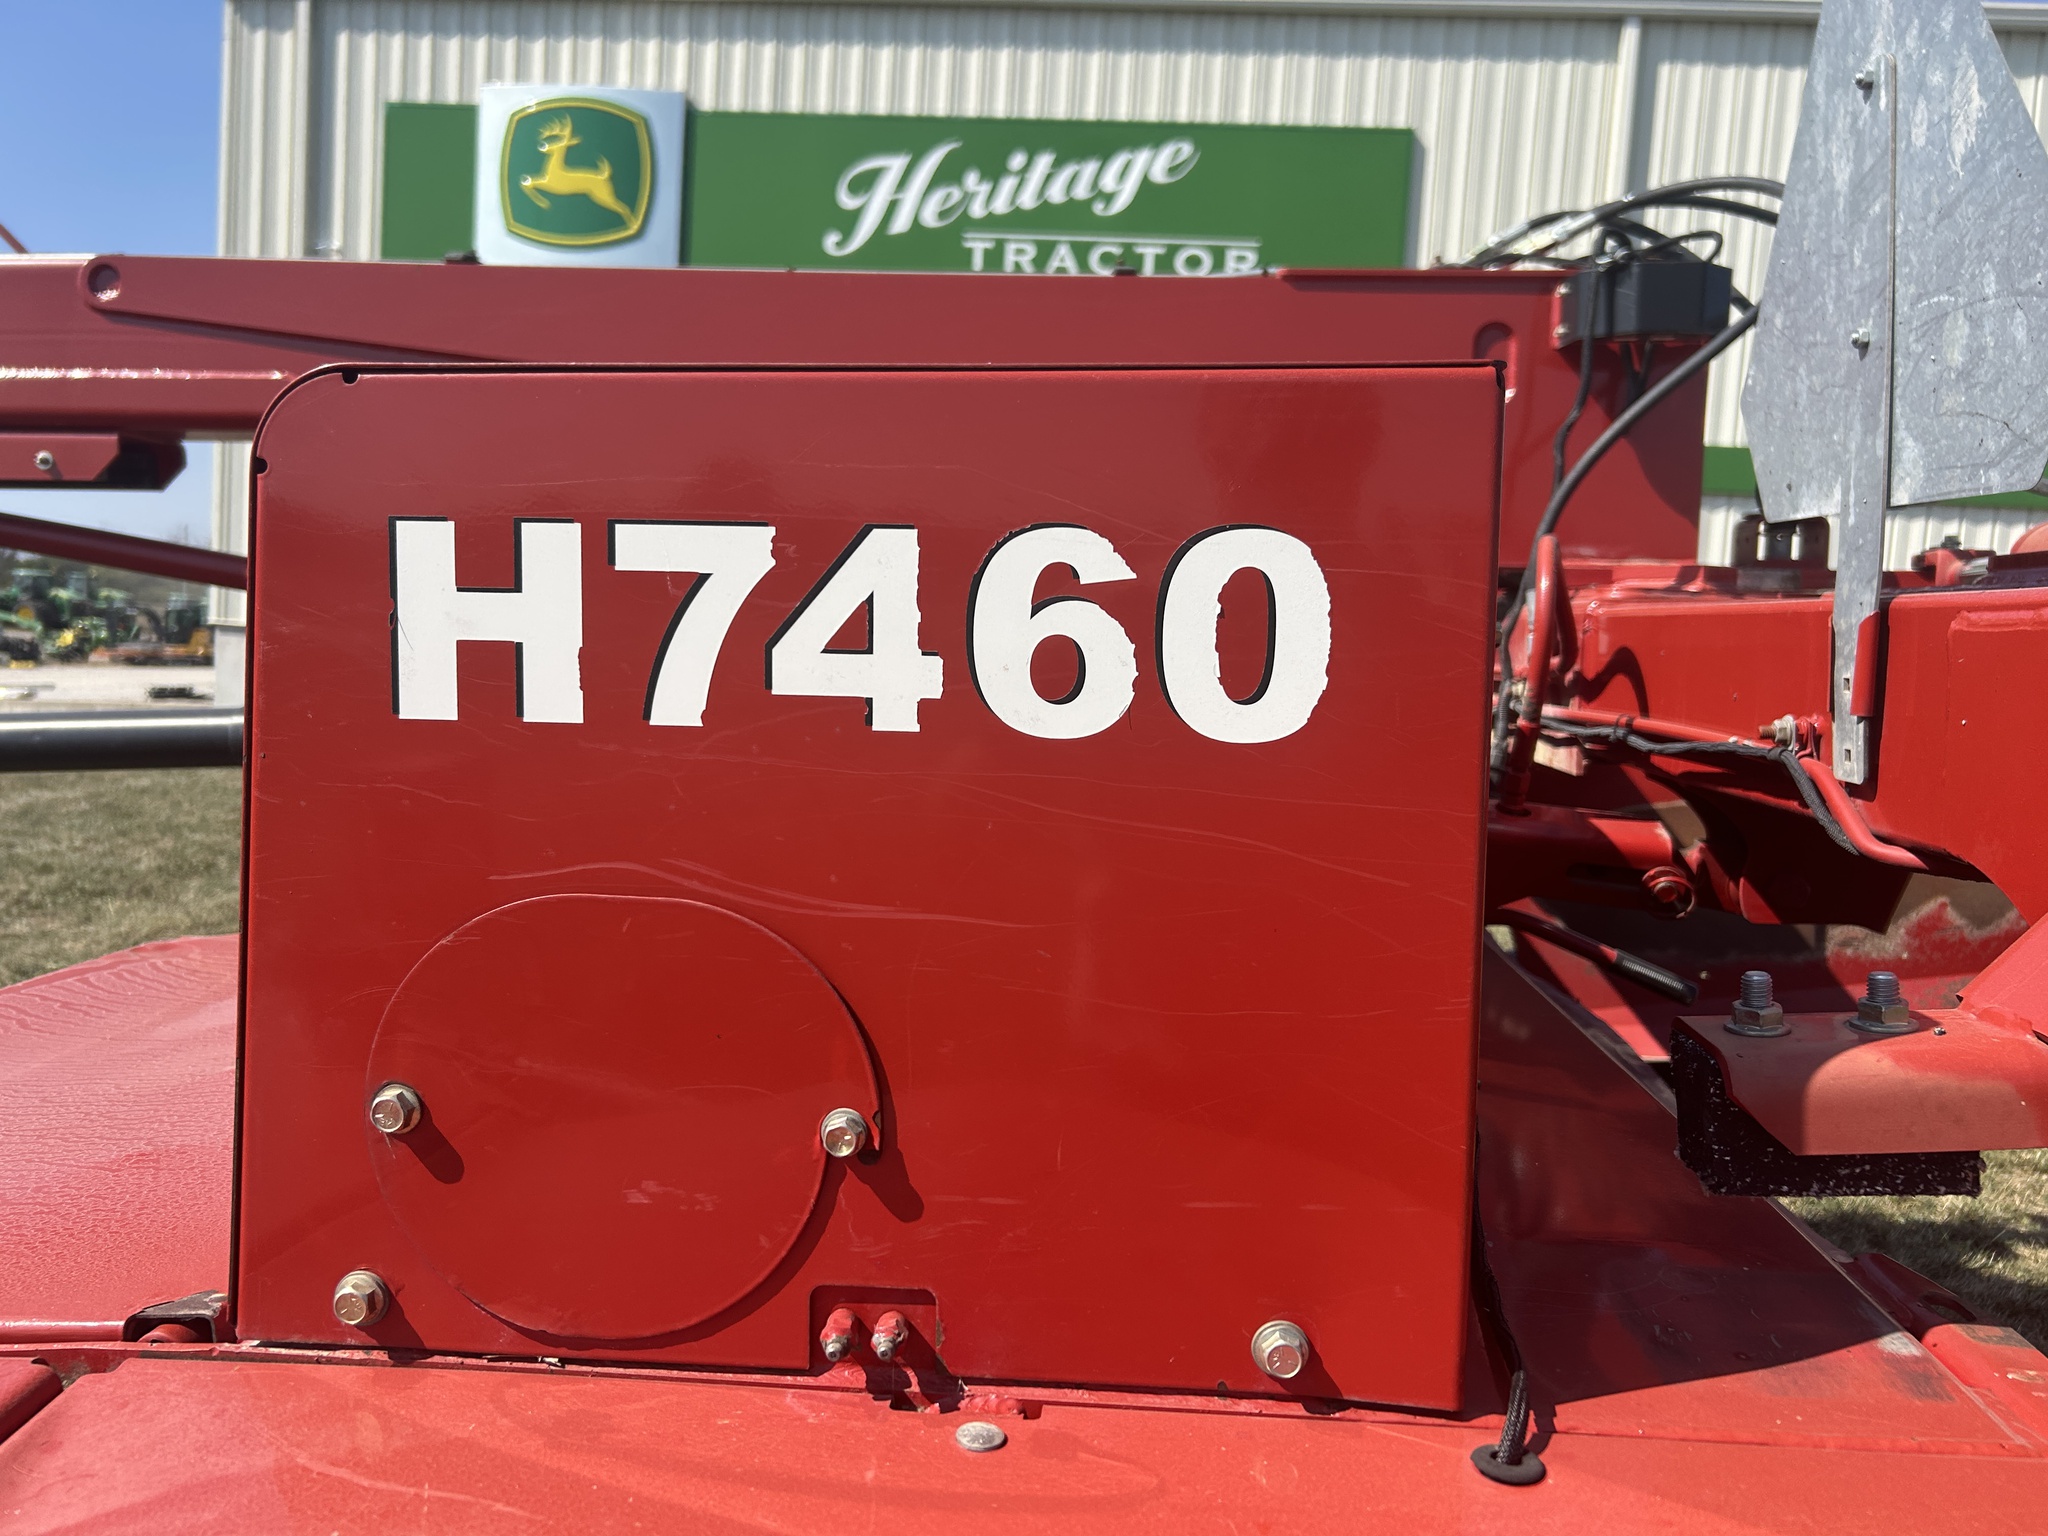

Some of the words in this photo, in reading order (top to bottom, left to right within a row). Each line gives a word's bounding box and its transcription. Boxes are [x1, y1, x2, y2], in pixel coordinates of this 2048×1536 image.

[822, 137, 1201, 257] Heritage
[962, 239, 1261, 276] TRACTOR
[390, 516, 1333, 744] H7460
